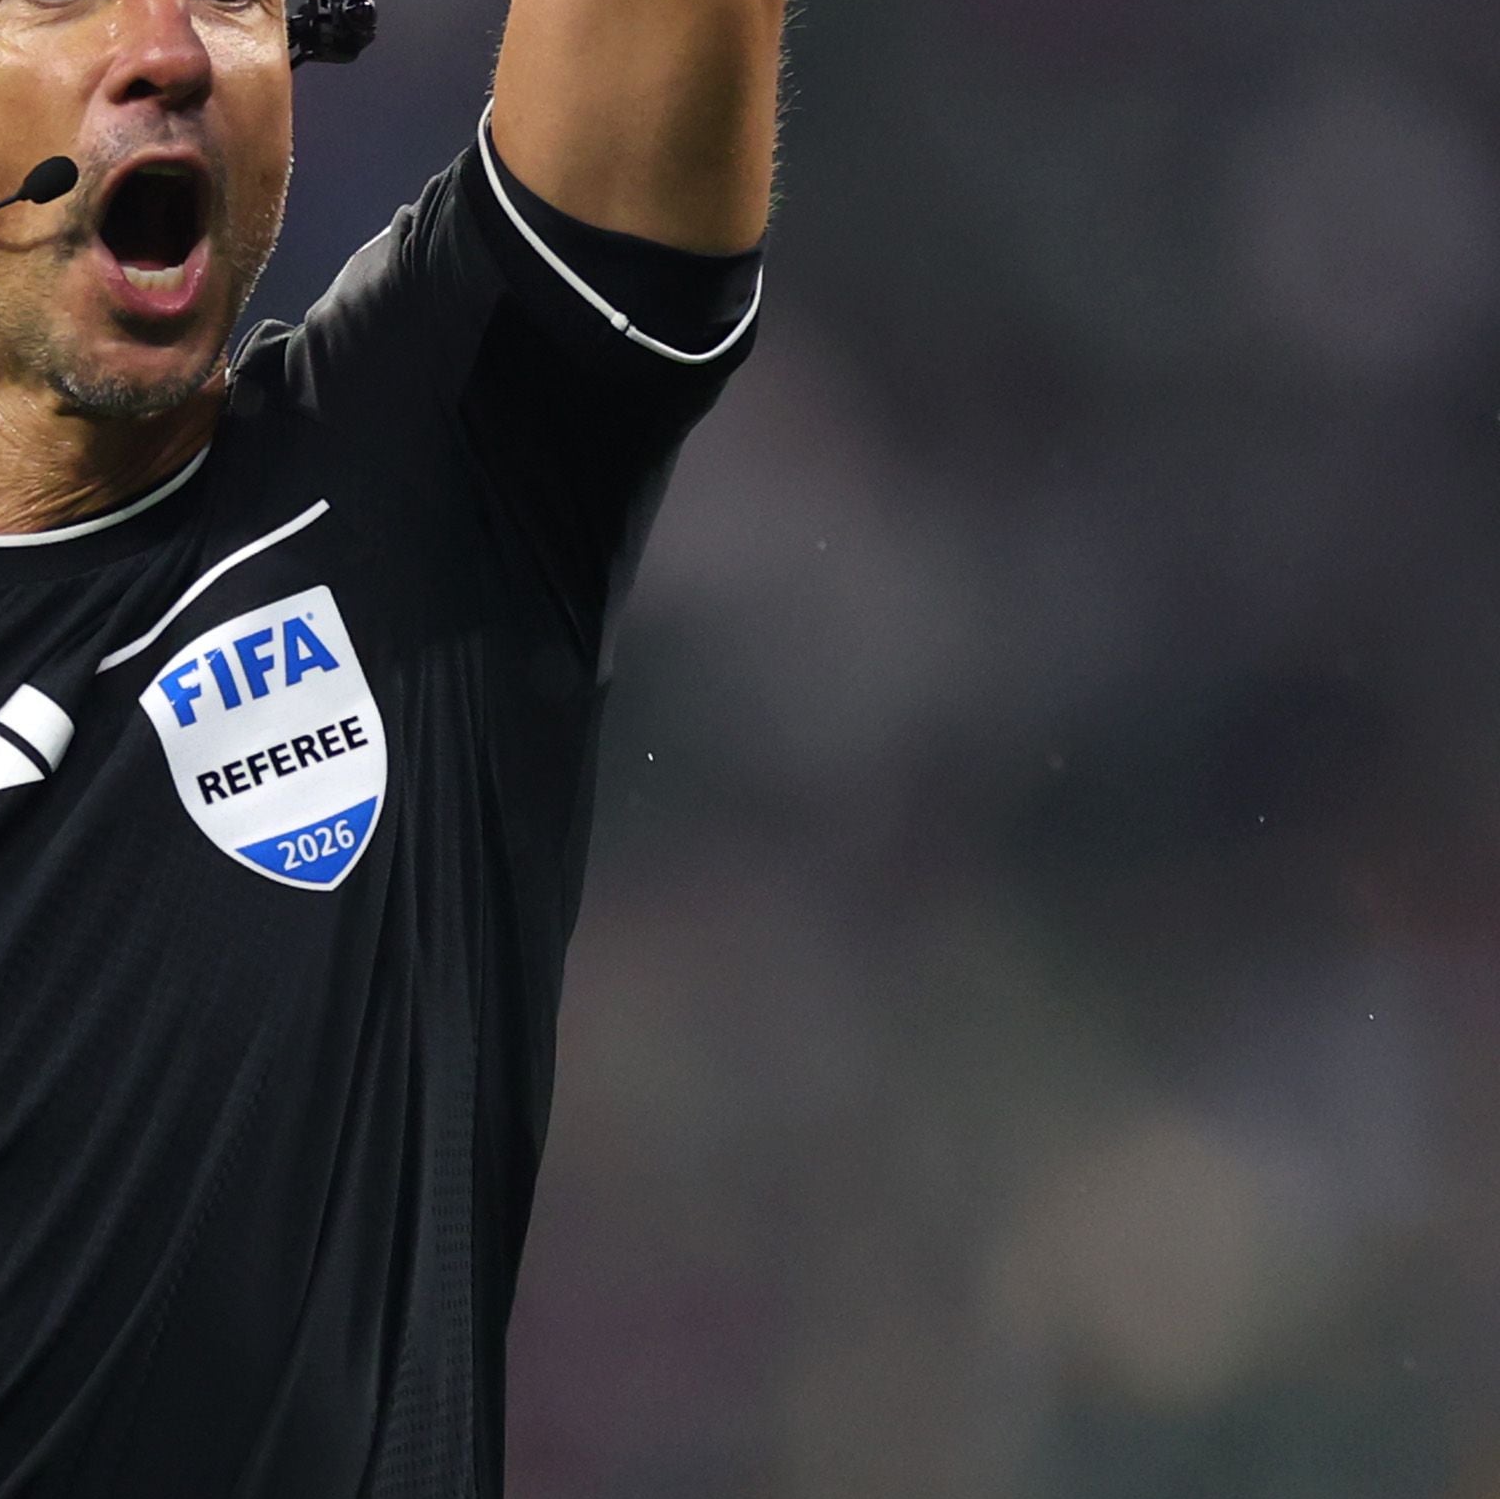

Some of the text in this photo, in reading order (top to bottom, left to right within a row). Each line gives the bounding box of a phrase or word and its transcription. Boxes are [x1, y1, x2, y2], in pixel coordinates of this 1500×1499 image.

[158, 617, 340, 728] FIFA
[196, 716, 369, 805] REFEREE
[277, 819, 355, 871] 2026
